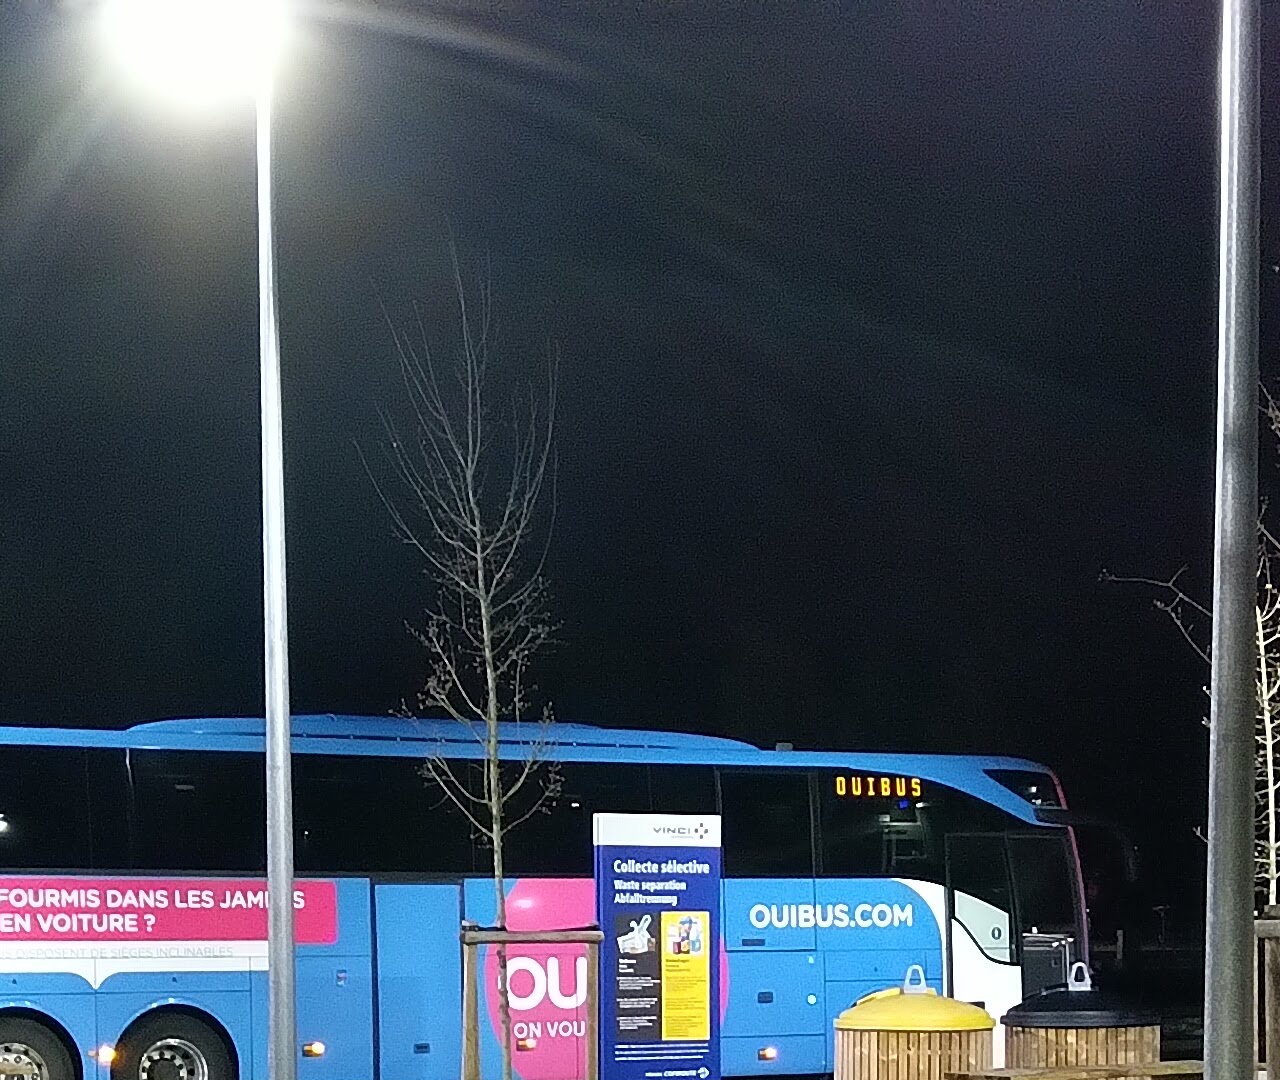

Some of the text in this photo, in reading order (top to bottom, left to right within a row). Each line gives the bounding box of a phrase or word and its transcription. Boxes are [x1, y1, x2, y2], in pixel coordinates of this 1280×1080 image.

[836, 776, 921, 796] OUIBUS
[653, 827, 691, 835] VINCI
[613, 859, 710, 874] Collecte sélective
[613, 879, 687, 893] Waste separation
[106, 889, 169, 909] DANS
[174, 890, 214, 909] LES
[220, 890, 305, 909] JAMS
[36, 913, 139, 933] VOITURE
[143, 914, 156, 932] ?
[749, 903, 913, 929] OUIBUS.COM
[90, 947, 108, 959] DE
[513, 1020, 586, 1039] ON VOU
